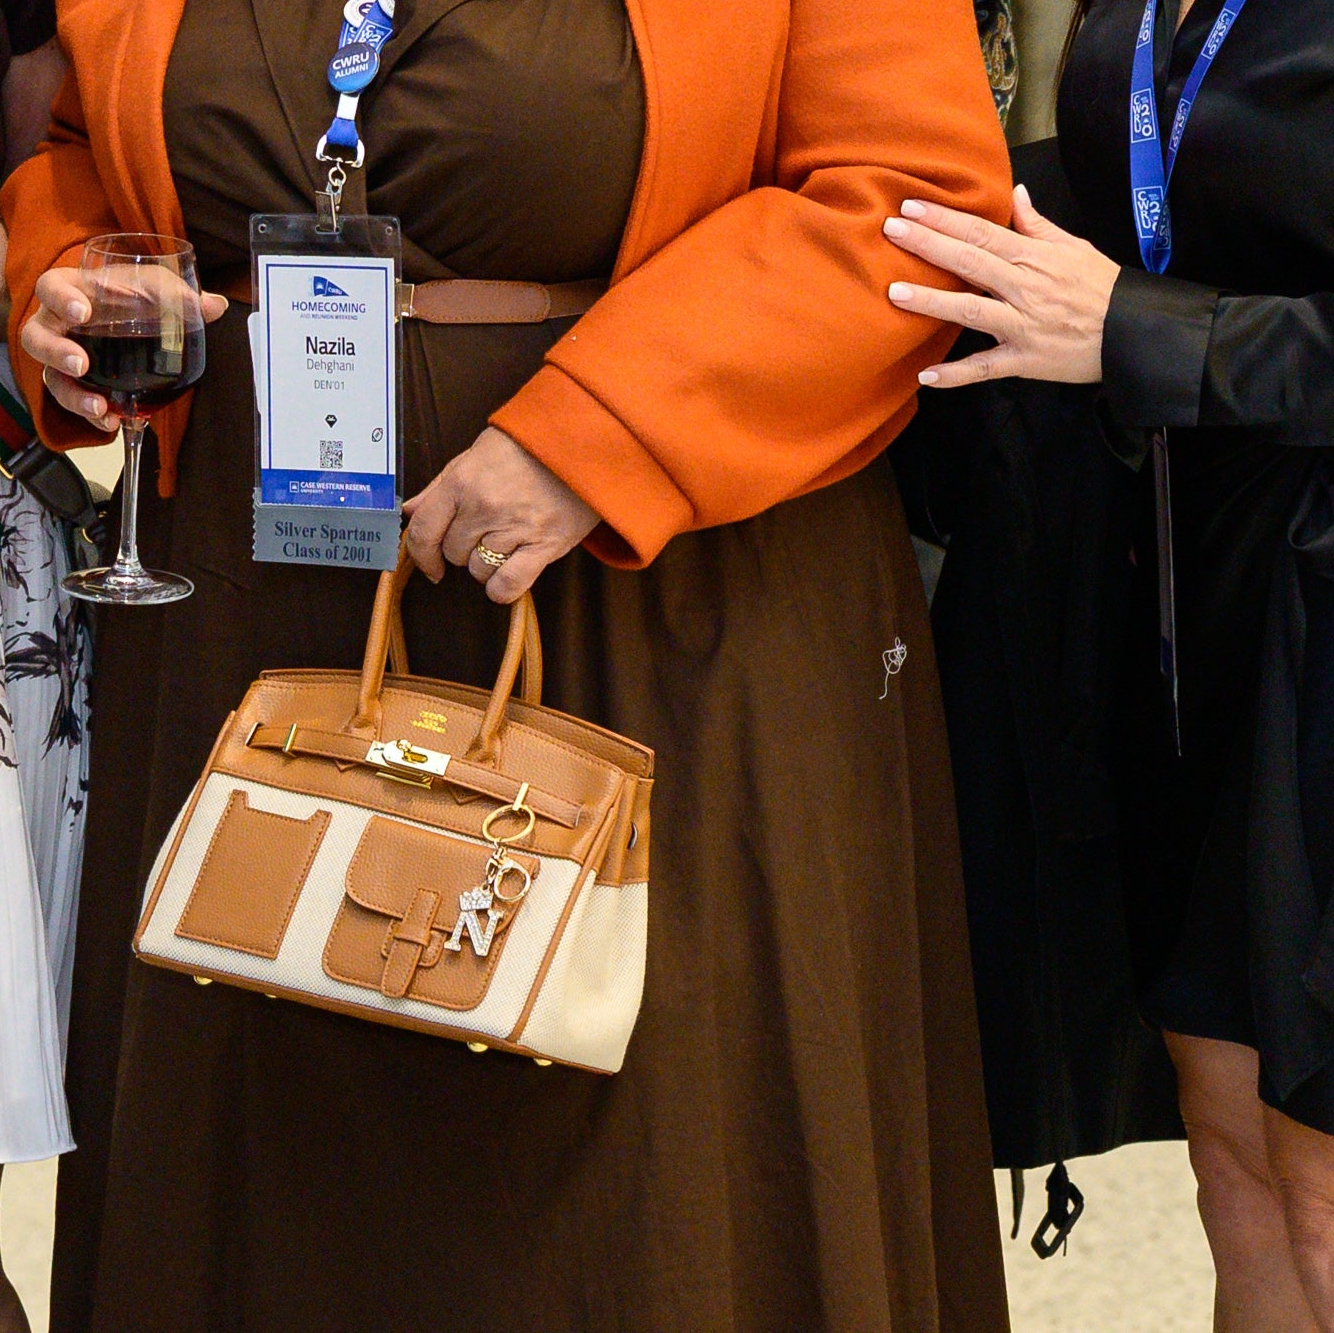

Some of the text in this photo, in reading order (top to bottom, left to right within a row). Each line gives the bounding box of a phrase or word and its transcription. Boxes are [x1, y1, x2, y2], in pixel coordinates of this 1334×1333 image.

[333, 52, 369, 70] CWRU
[335, 64, 369, 79] ALUMNI
[1133, 94, 1141, 133] CWRU
[1137, 190, 1151, 229] CWRU
[291, 301, 366, 314] HOMECOMING
[305, 336, 355, 356] Nazila
[307, 358, 355, 374] Dehghani
[316, 482, 344, 490] WESTERN
[345, 484, 371, 492] RESERVE
[275, 521, 381, 544] Silver Spartans
[283, 542, 371, 562] Class of 2001
